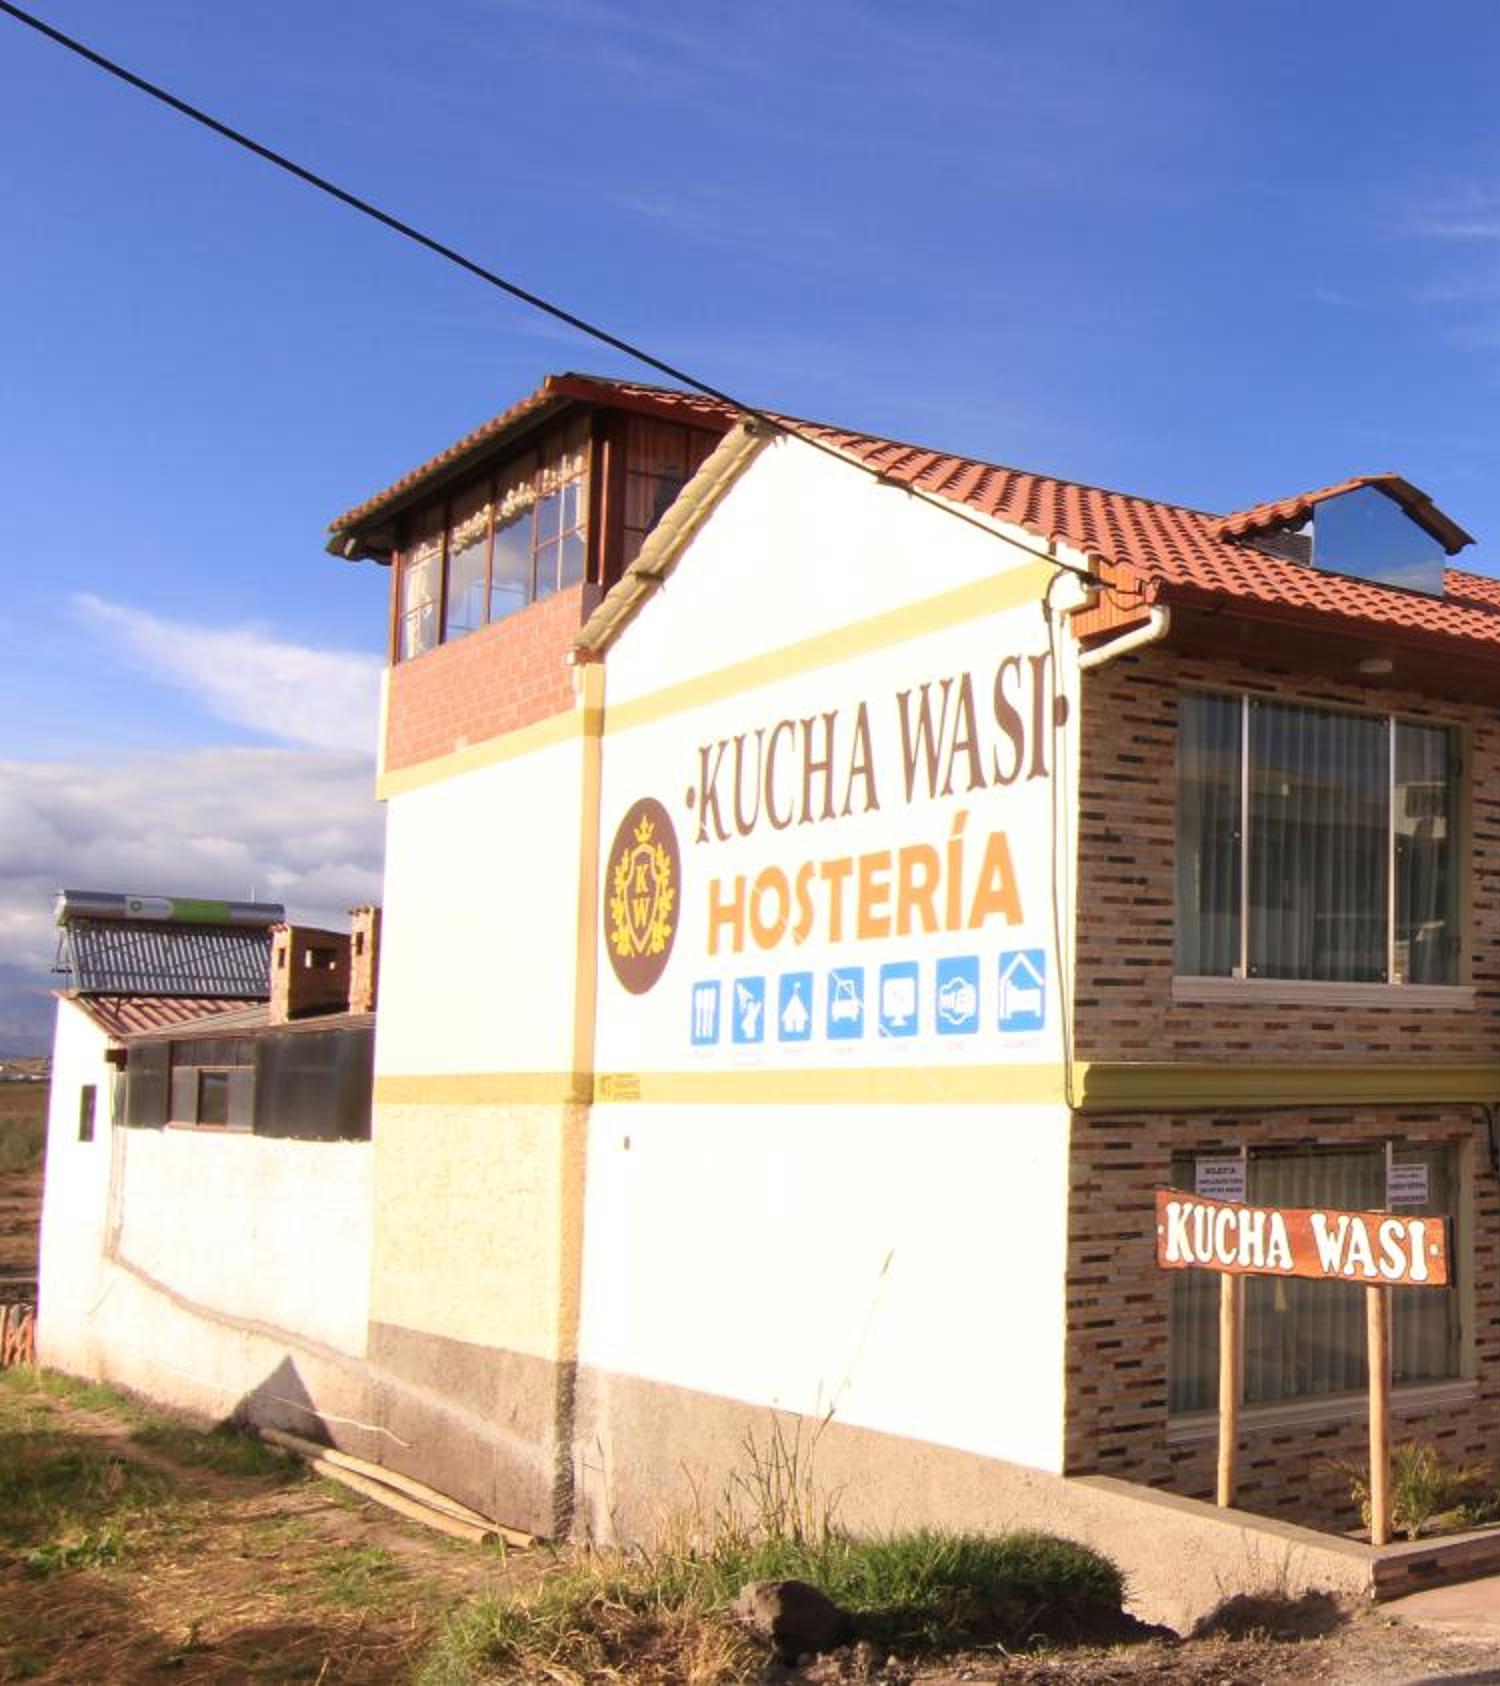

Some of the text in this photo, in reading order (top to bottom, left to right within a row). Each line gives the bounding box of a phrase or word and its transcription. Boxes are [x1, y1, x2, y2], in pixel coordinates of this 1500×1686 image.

[696, 653, 1056, 844] KUCHA WASI
[632, 898, 649, 929] W
[635, 863, 649, 891] K
[705, 809, 1025, 956] HOSTERÍA
[1165, 1202, 1429, 1281] KUCHA WASI
